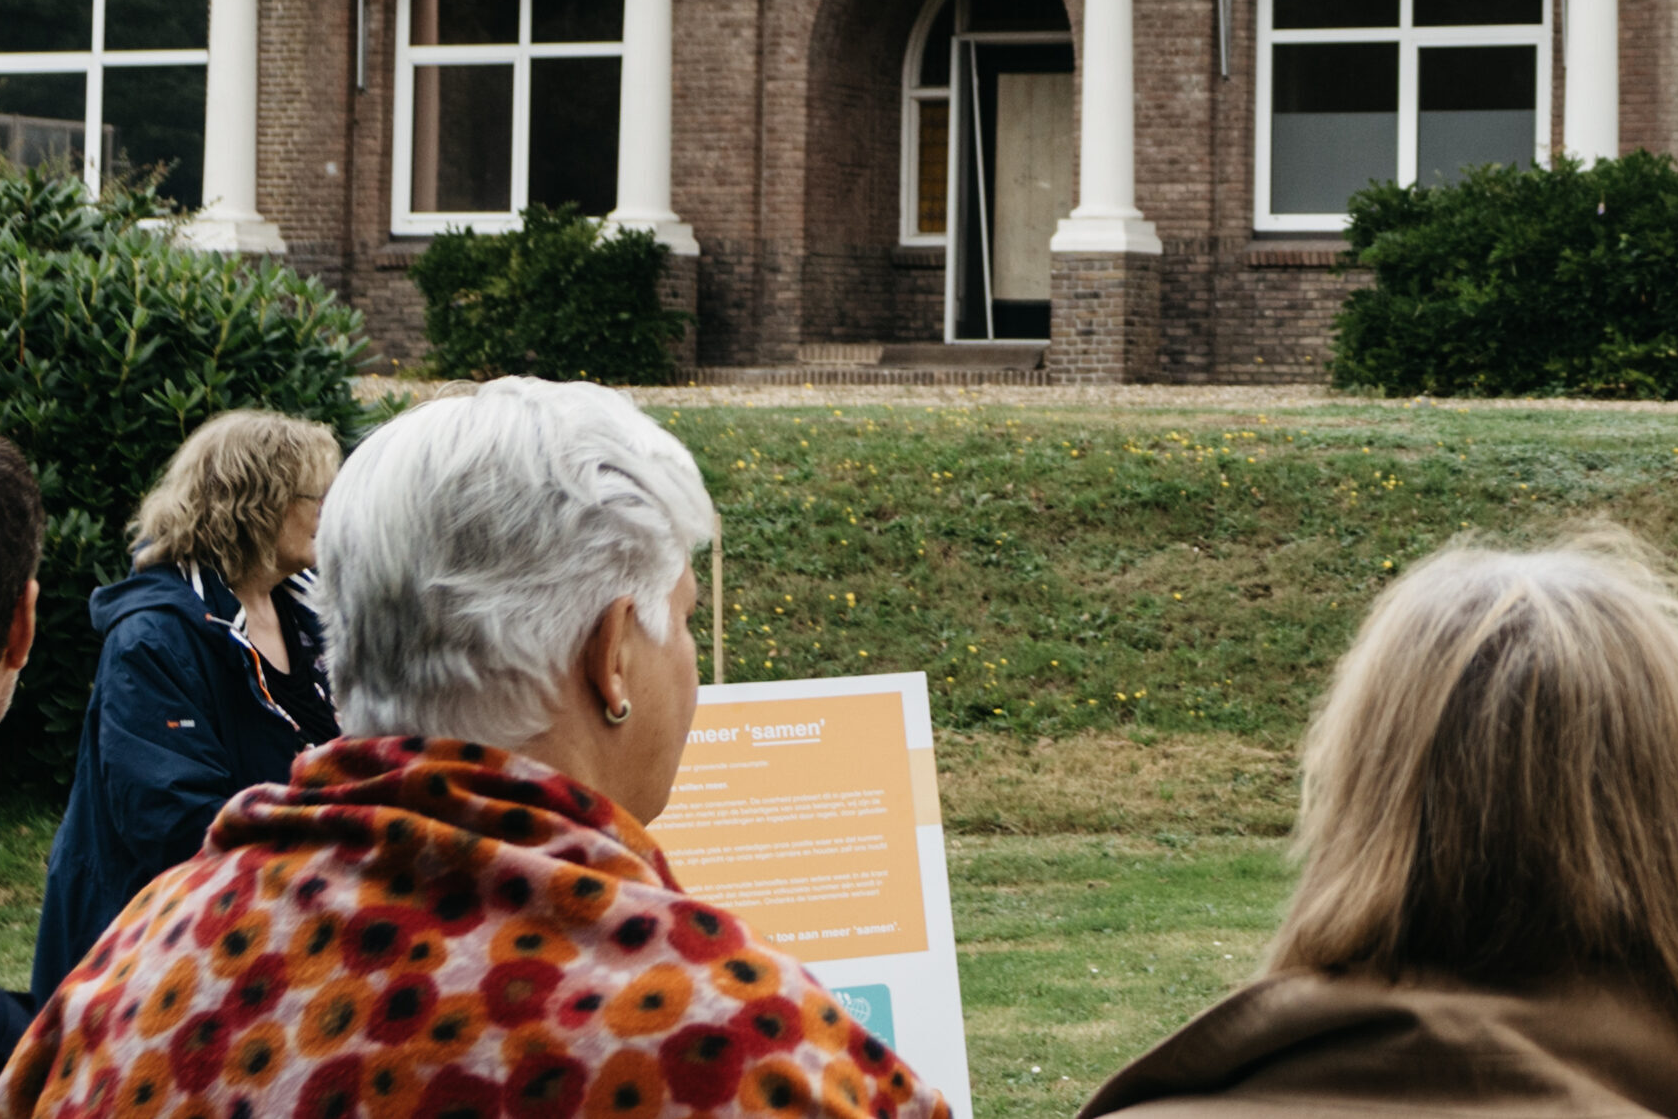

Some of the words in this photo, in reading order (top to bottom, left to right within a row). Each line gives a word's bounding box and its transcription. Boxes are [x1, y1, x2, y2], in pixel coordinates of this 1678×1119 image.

[686, 728, 739, 745] meer
[776, 931, 794, 941] toe
[798, 931, 819, 939] aan
[821, 928, 850, 937] meer
